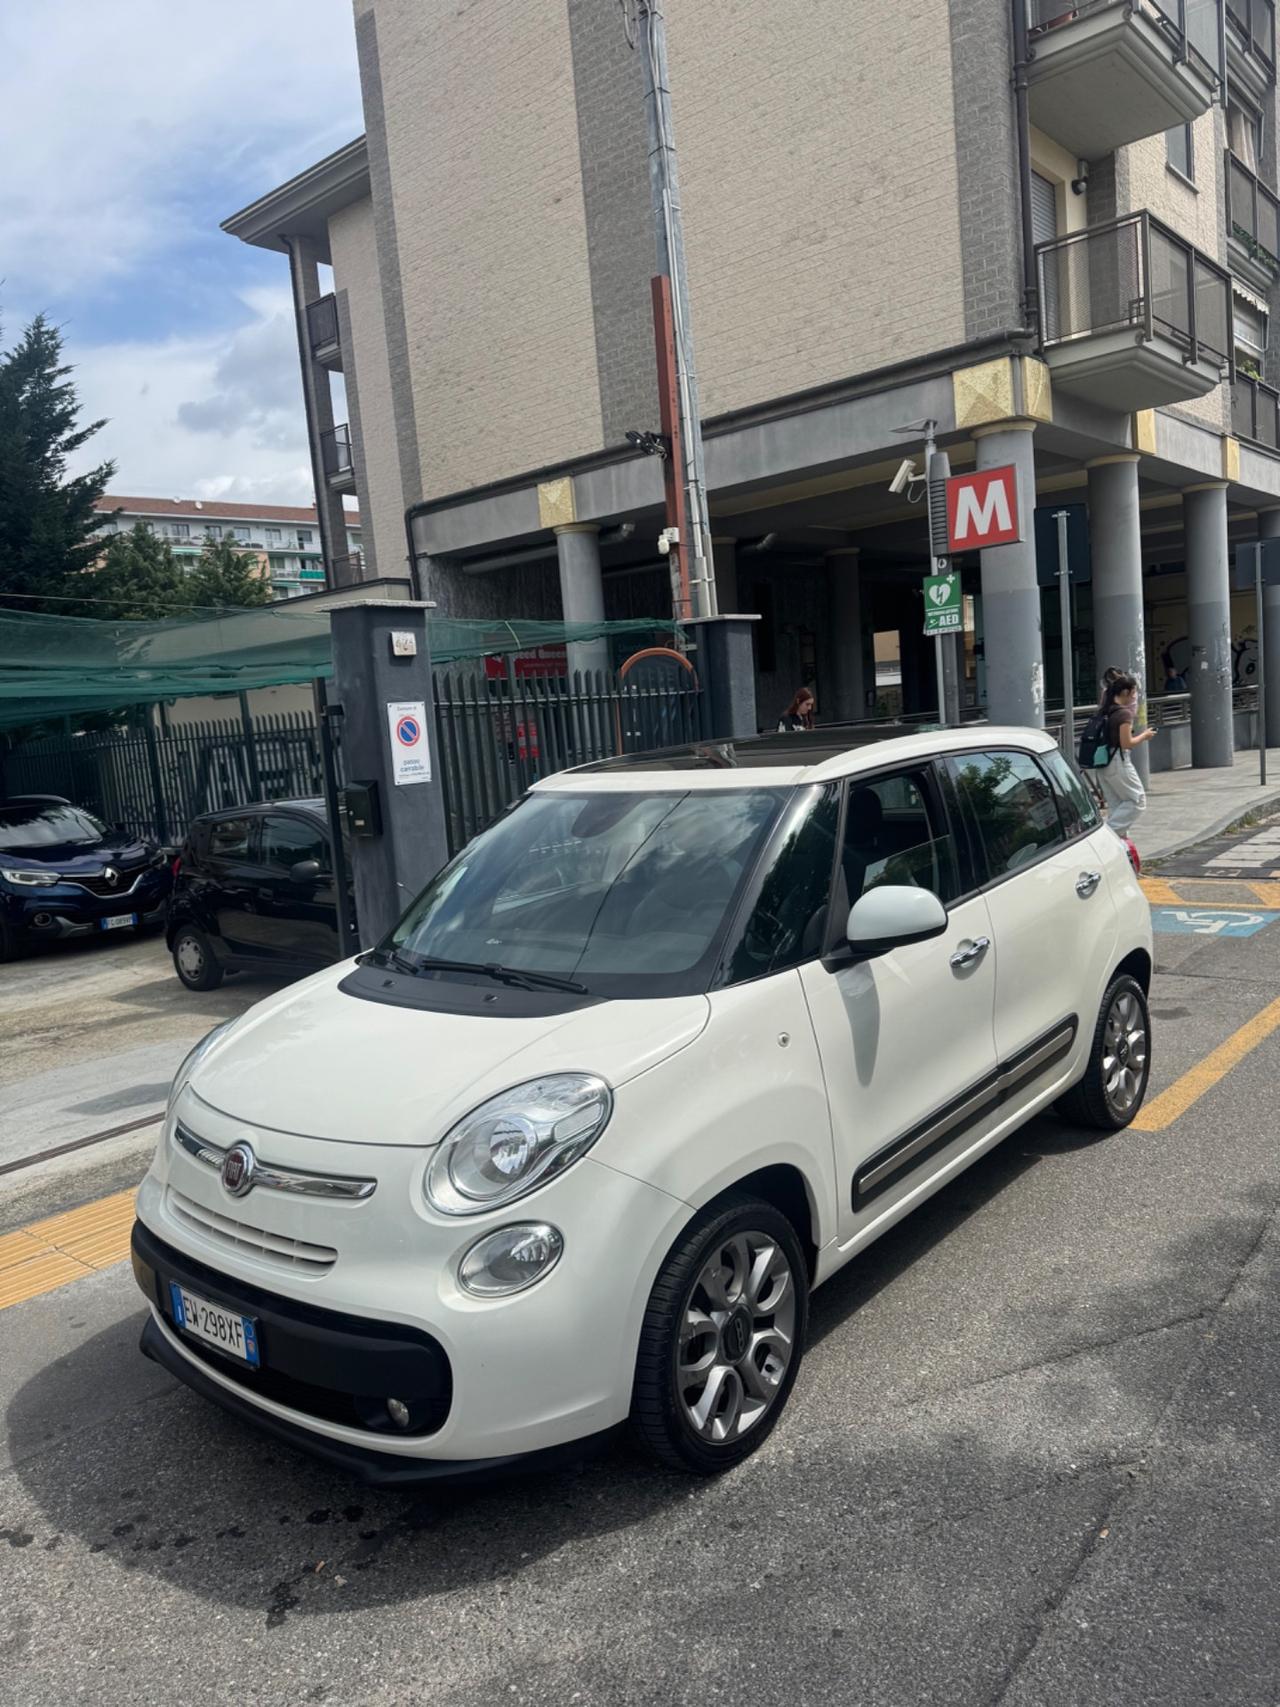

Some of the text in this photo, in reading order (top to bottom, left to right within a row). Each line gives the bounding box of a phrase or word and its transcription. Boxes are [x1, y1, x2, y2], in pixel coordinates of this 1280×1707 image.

[954, 479, 1012, 540] M
[939, 614, 959, 627] AED
[227, 1159, 243, 1181] FIAT
[201, 1306, 243, 1349] 298XF
